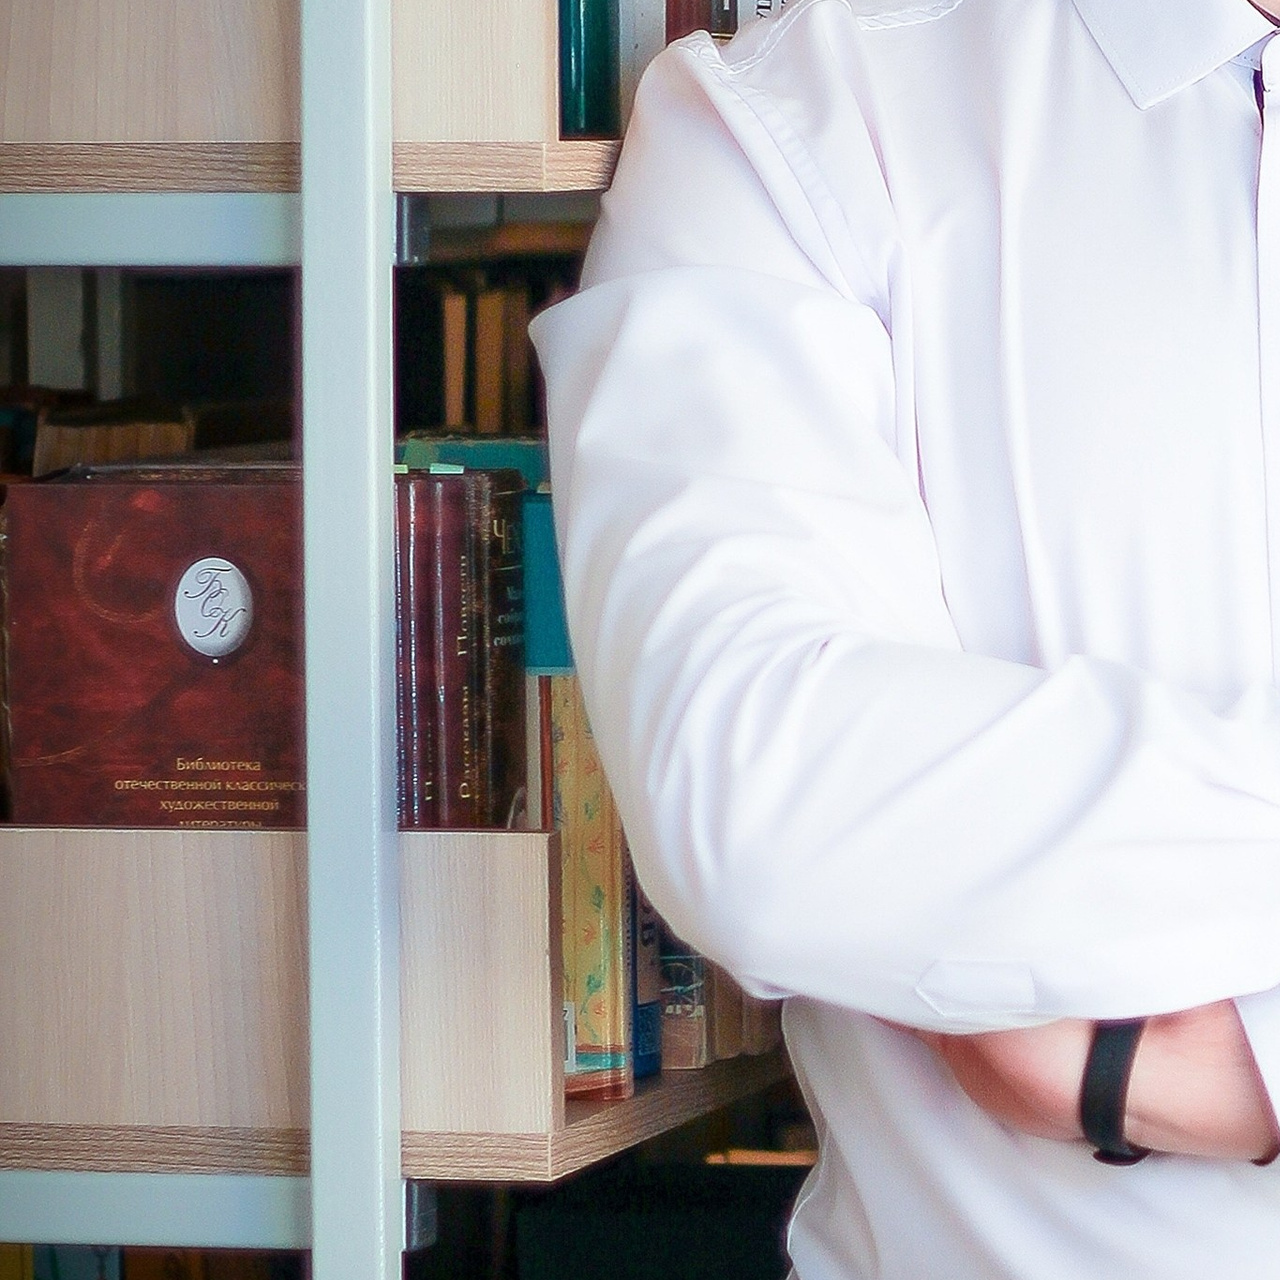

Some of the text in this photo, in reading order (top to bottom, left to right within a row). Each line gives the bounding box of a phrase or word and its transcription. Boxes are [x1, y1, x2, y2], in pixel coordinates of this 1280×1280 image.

[456, 555, 468, 657] Повести
[176, 756, 261, 772] Библиотека
[114, 777, 222, 793] отечественной
[159, 799, 280, 815] художественной
